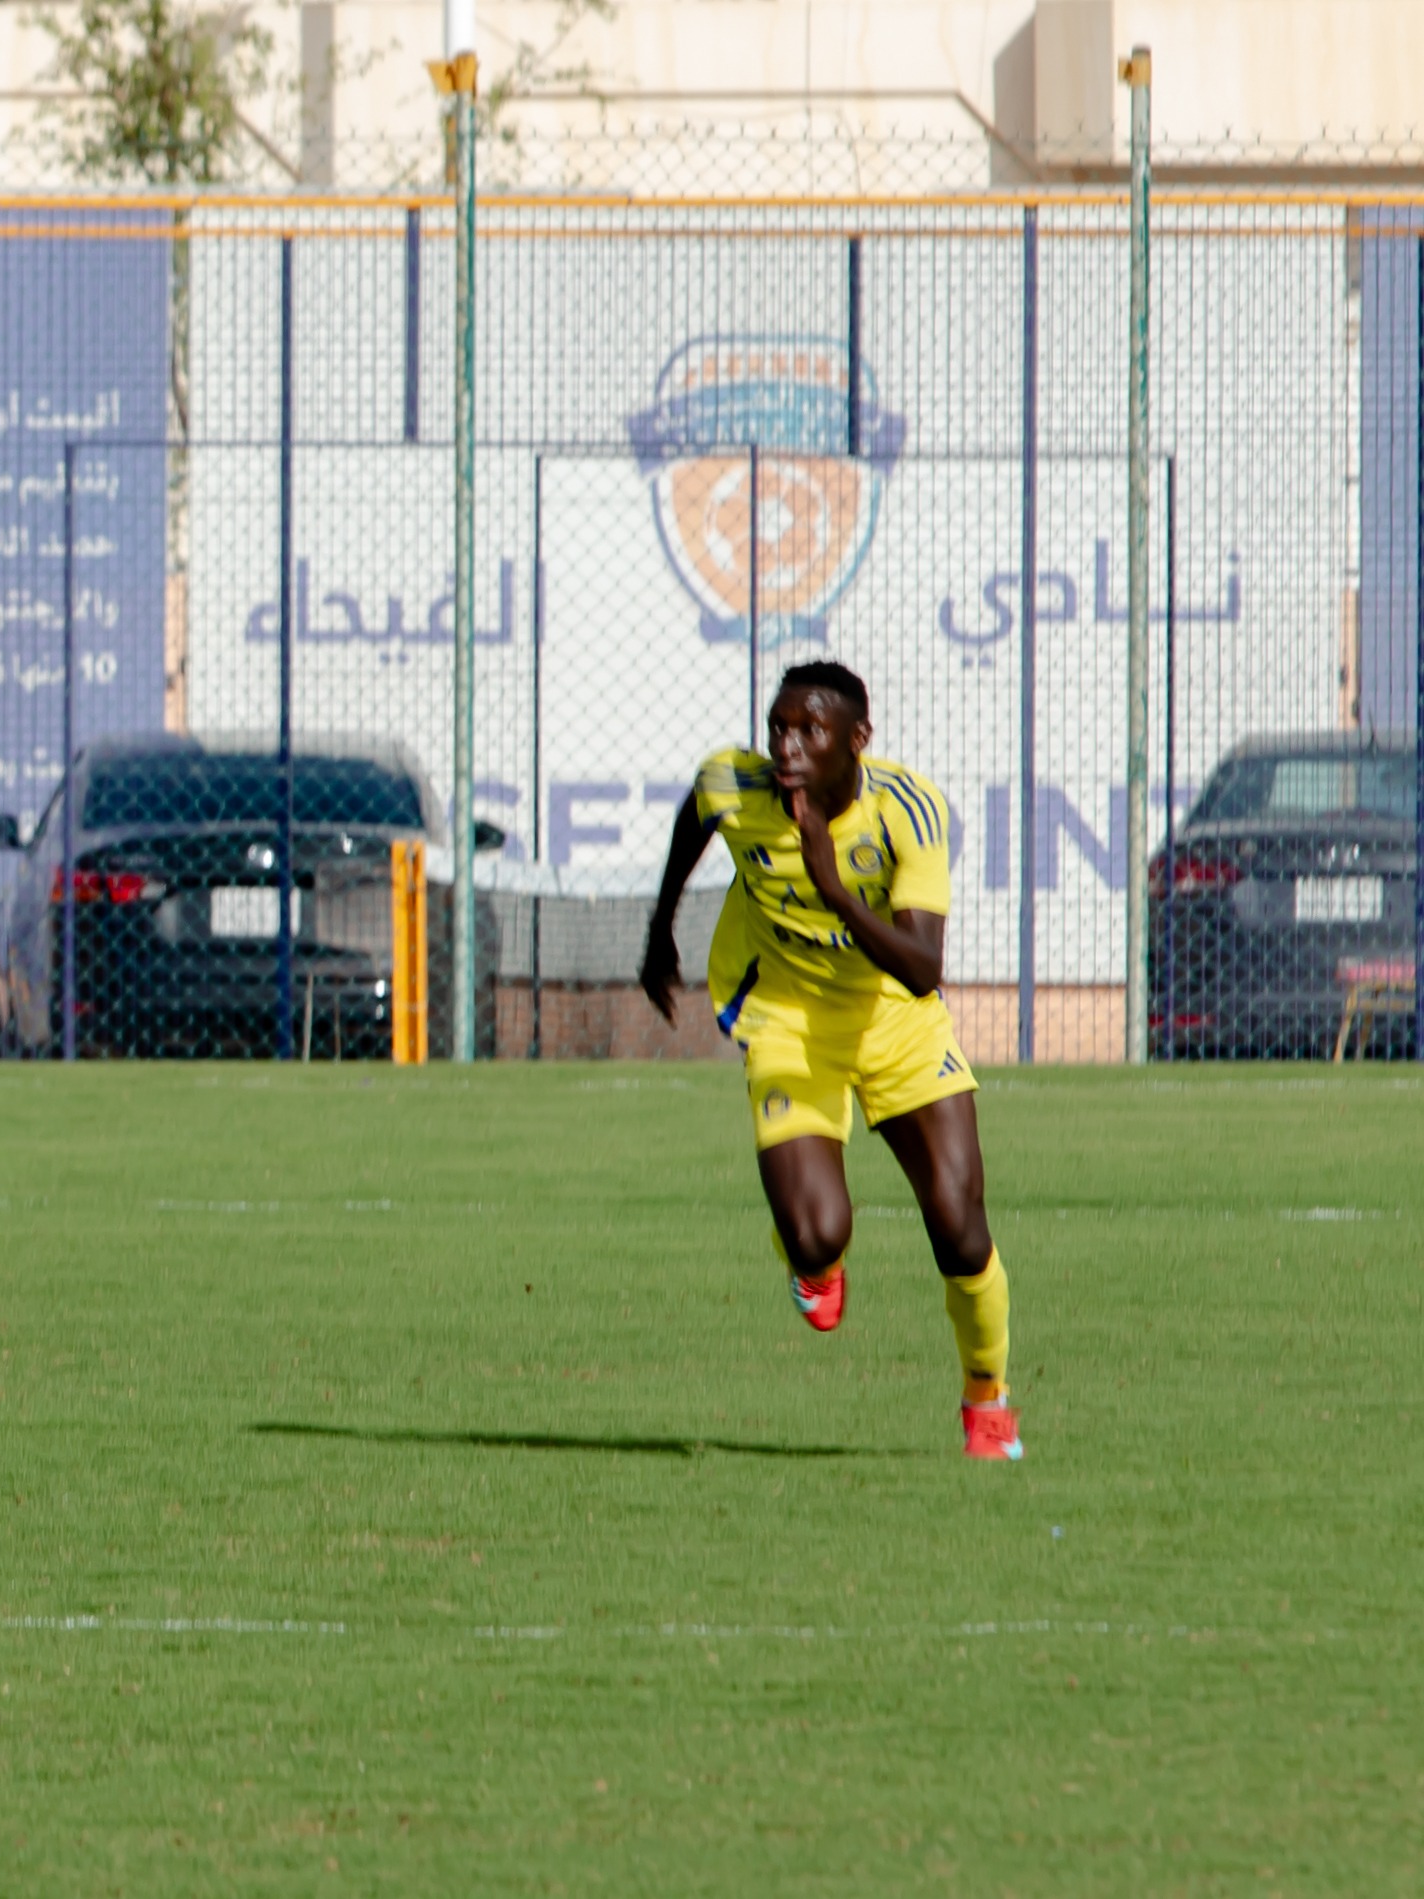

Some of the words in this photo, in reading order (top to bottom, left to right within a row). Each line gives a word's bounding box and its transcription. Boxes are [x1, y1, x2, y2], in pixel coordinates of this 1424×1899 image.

[243, 556, 546, 665] الفيحاء
[938, 537, 1242, 668] نادي
[80, 651, 118, 684] 10
